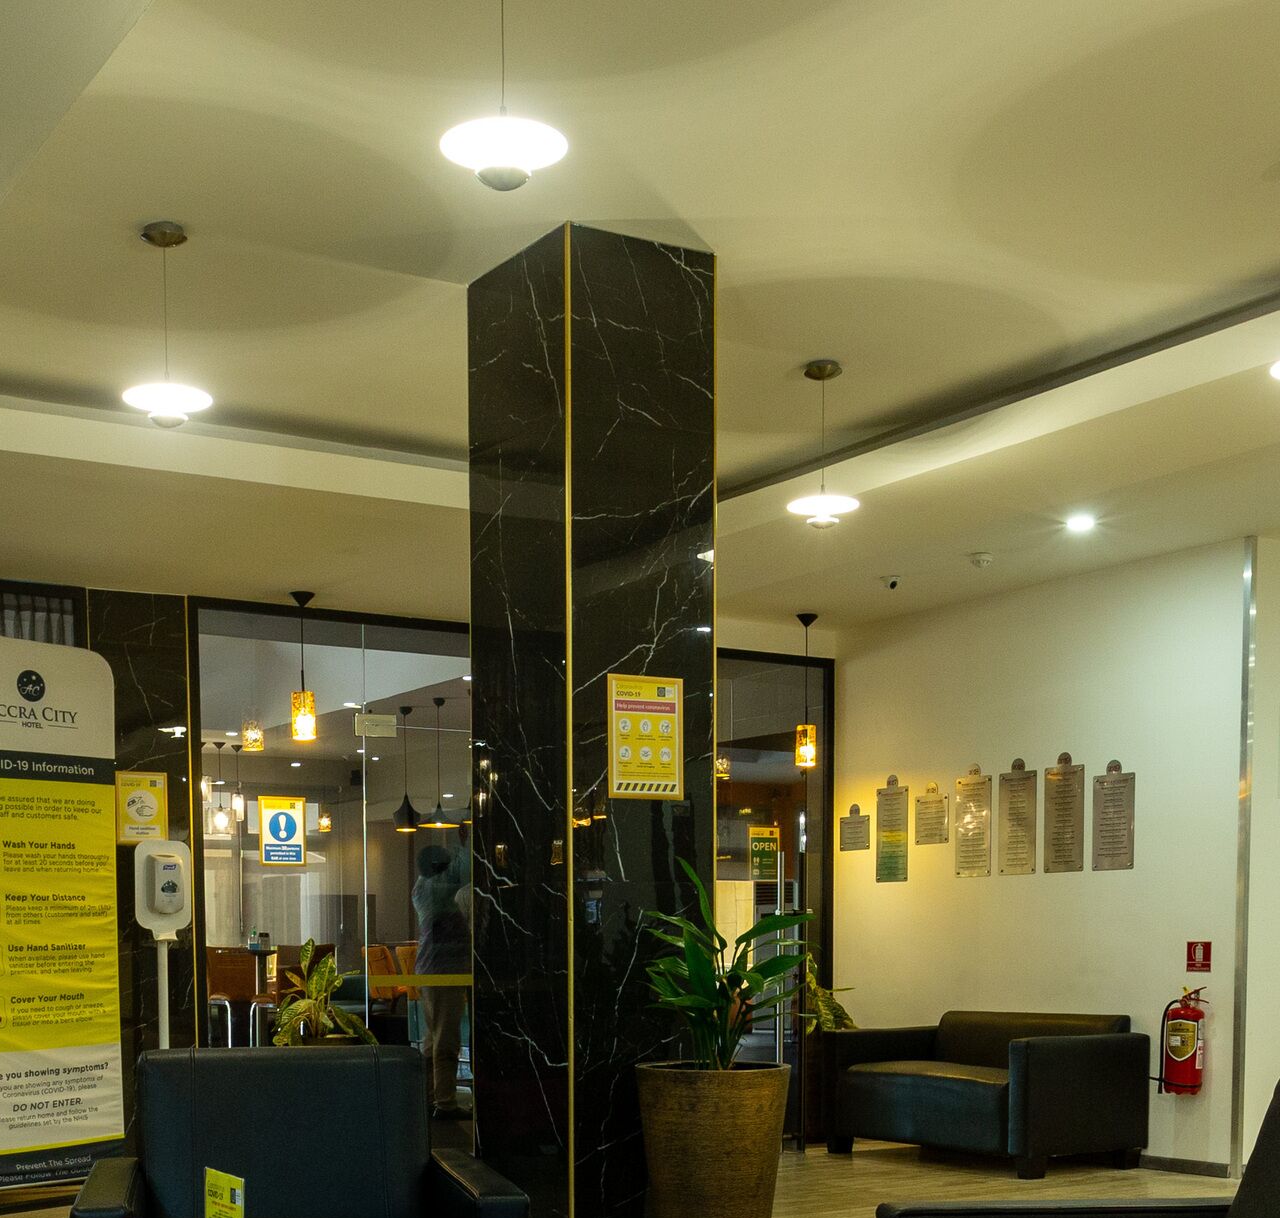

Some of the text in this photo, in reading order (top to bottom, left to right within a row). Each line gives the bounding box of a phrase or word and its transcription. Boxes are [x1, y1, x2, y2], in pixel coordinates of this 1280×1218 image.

[22, 721, 43, 729] HOTEL
[32, 761, 95, 775] Information
[76, 799, 96, 807] doing
[2, 840, 76, 850] Wash Your Hands
[752, 842, 777, 851] OPEN
[2, 851, 24, 859] Please
[5, 893, 86, 903] Keep Your Distance
[8, 942, 86, 952] Use Hand Sanitizer
[10, 992, 85, 1004] Cover Your Mouth
[5, 1071, 22, 1081] you
[24, 1067, 60, 1078] showing
[62, 1061, 109, 1075] symptoms?
[0, 1085, 13, 1093] you
[25, 1080, 51, 1088] showing
[65, 1076, 96, 1086] symptoms
[2, 1089, 40, 1099] Coronavirus
[77, 1083, 98, 1091] please
[13, 1097, 84, 1112] DO NOT ENTER.
[17, 1114, 37, 1122] return
[56, 1109, 68, 1117] and
[68, 1108, 87, 1116] follow
[8, 1121, 42, 1130] guidelines
[15, 1154, 92, 1171] Prevent The Spread
